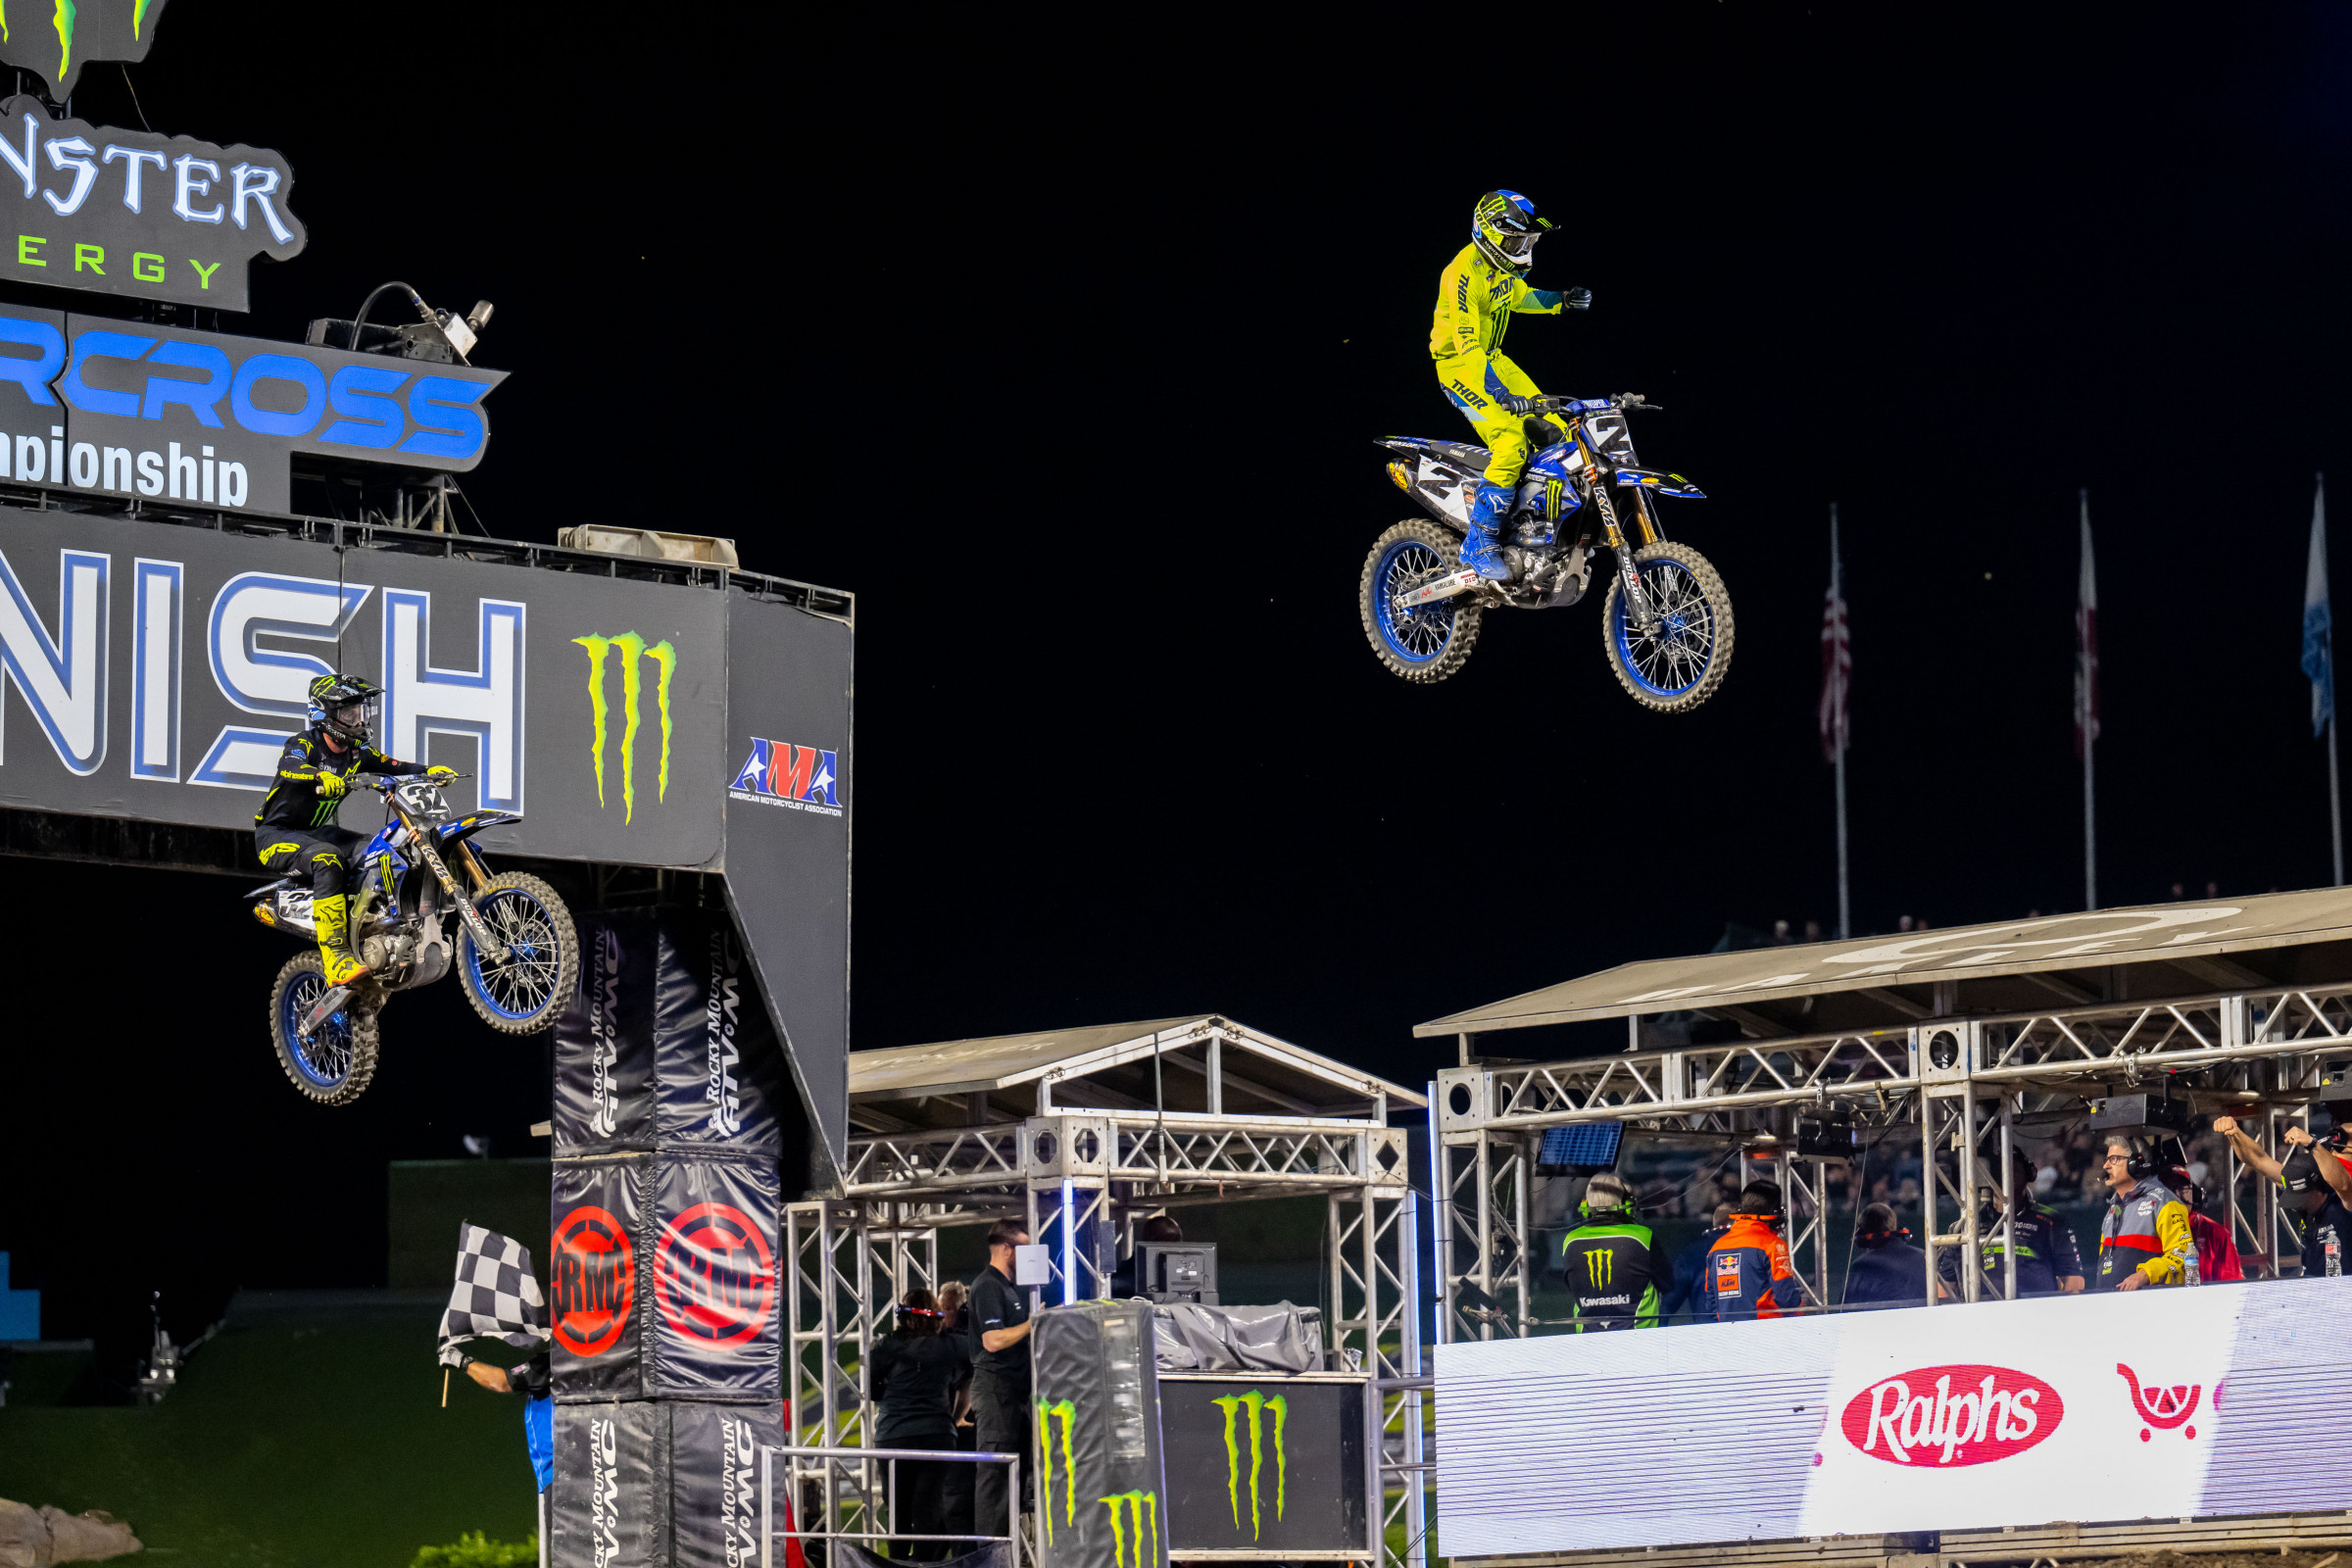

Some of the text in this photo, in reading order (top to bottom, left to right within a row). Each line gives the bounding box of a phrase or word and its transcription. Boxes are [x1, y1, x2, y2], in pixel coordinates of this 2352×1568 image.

[18, 234, 222, 290] ERGY
[1457, 273, 1470, 314] THOR
[0, 316, 491, 460] RCROSS
[1451, 378, 1489, 411] THOR
[1596, 416, 1632, 451] 2
[1415, 466, 1464, 501] 2
[1593, 486, 1616, 527] KYB
[1623, 555, 1642, 604] DUNLOP
[0, 548, 527, 816] NISH
[728, 736, 844, 808] AMA
[407, 784, 449, 812] 32
[729, 791, 843, 817] AMERICAN MOTORCYCLIST ASSOCIATION
[421, 846, 451, 879] KYB
[459, 898, 488, 936] DUNLOP
[591, 929, 606, 1106] ROCKY MOUNTAIN
[706, 928, 722, 1104] ROCKY MOUNTAIN
[1579, 1294, 1631, 1308] Kawasaki
[1863, 1374, 2040, 1464] Ralphs
[590, 1417, 606, 1529] MOUNTAIN
[720, 1417, 737, 1529] MOUNTAIN
